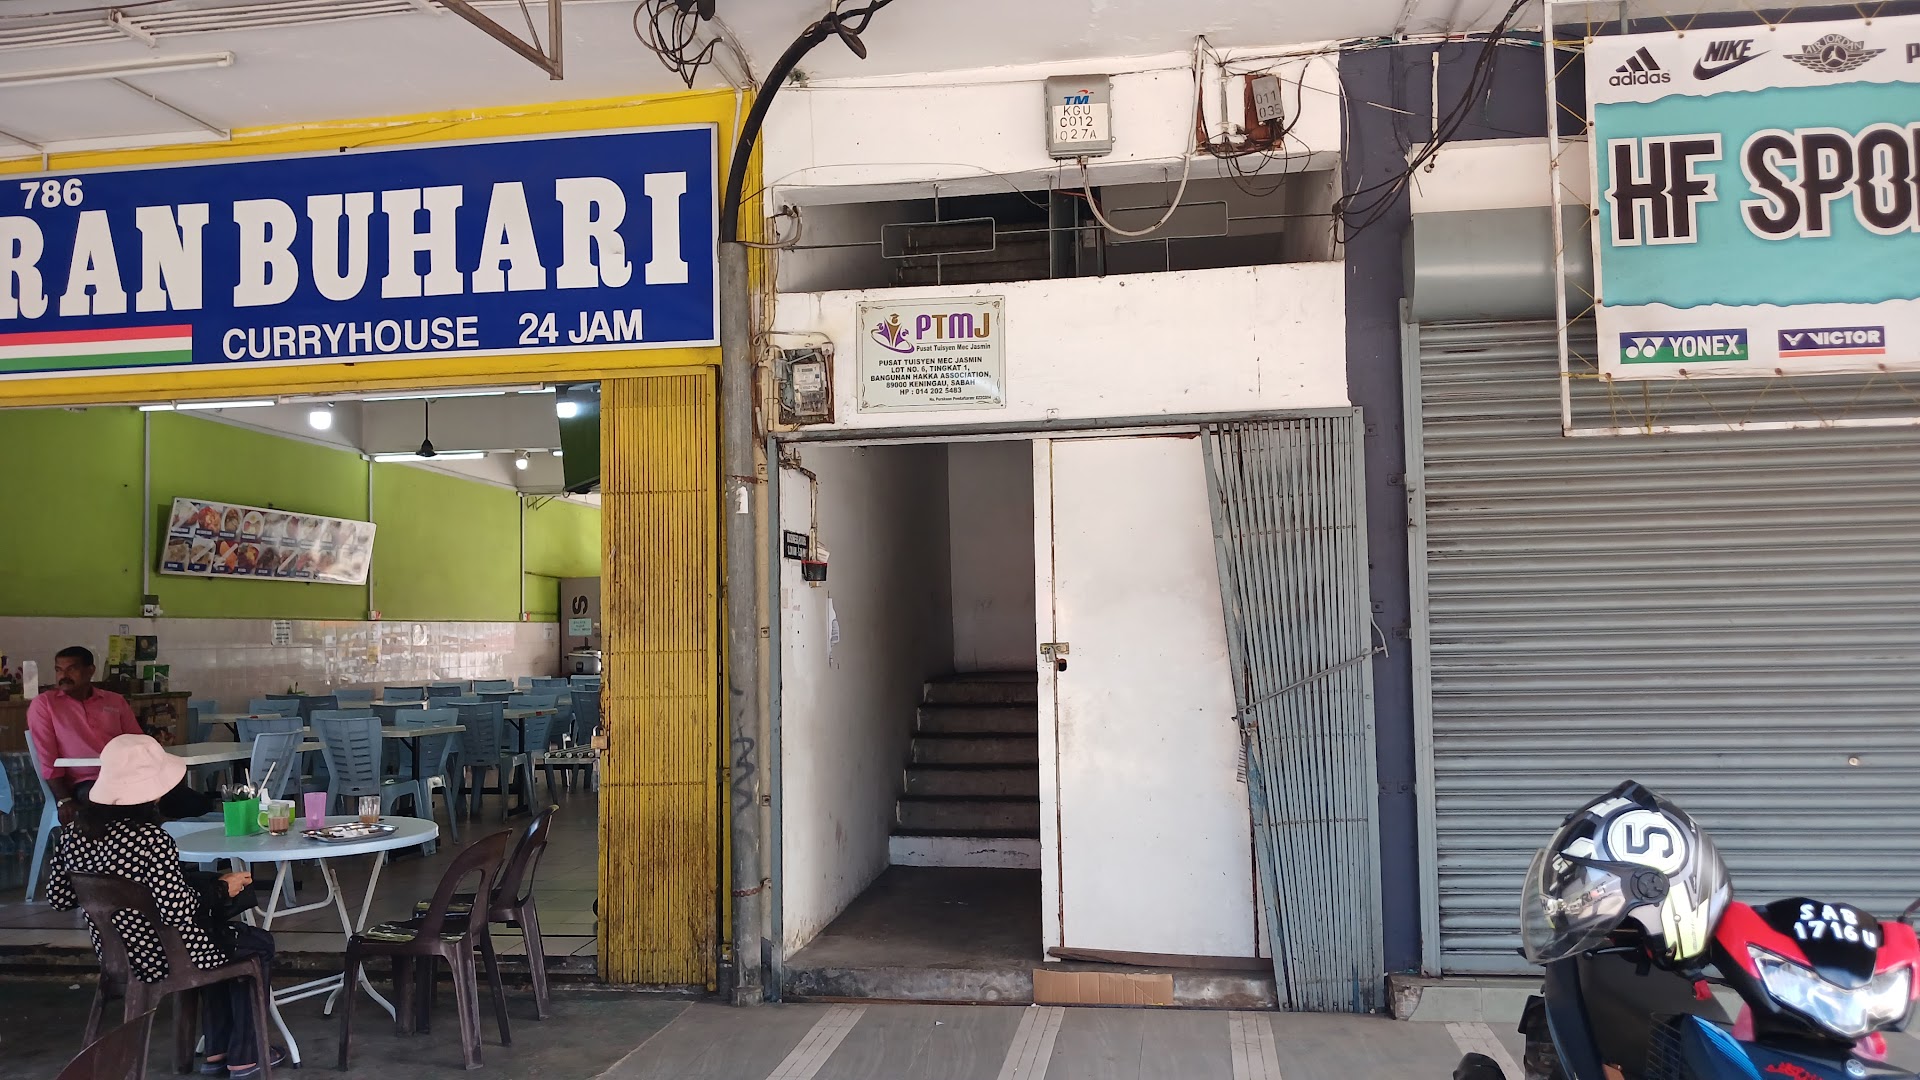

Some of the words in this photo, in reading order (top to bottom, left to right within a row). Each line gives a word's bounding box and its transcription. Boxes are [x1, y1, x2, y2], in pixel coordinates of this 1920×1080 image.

[1703, 39, 1755, 63] NIKE
[1609, 71, 1671, 87] adidas
[1063, 95, 1090, 106] TM
[1063, 105, 1091, 116] KGU
[1606, 134, 1721, 245] HF
[1741, 121, 1920, 241] SPO
[20, 178, 84, 210] 786
[233, 171, 690, 308] BUHARI
[916, 312, 990, 340] PTMJ
[222, 315, 480, 361] CURRYHOUSE
[518, 312, 559, 345] 24
[568, 308, 643, 344] JAM
[1807, 330, 1881, 346] VICTOR
[933, 344, 956, 353] Tuisyen
[970, 342, 991, 350] Jasmin
[1668, 334, 1740, 358] YONEX
[904, 358, 936, 366] TUISYEN
[954, 356, 983, 364] JASMIN
[870, 374, 911, 382] BANGUNAN
[940, 371, 992, 380] ASSOCIATION,
[908, 379, 949, 388] KENINGAU,
[950, 378, 976, 386] SABAH
[899, 388, 910, 396] HP
[1799, 903, 1858, 926] SAB
